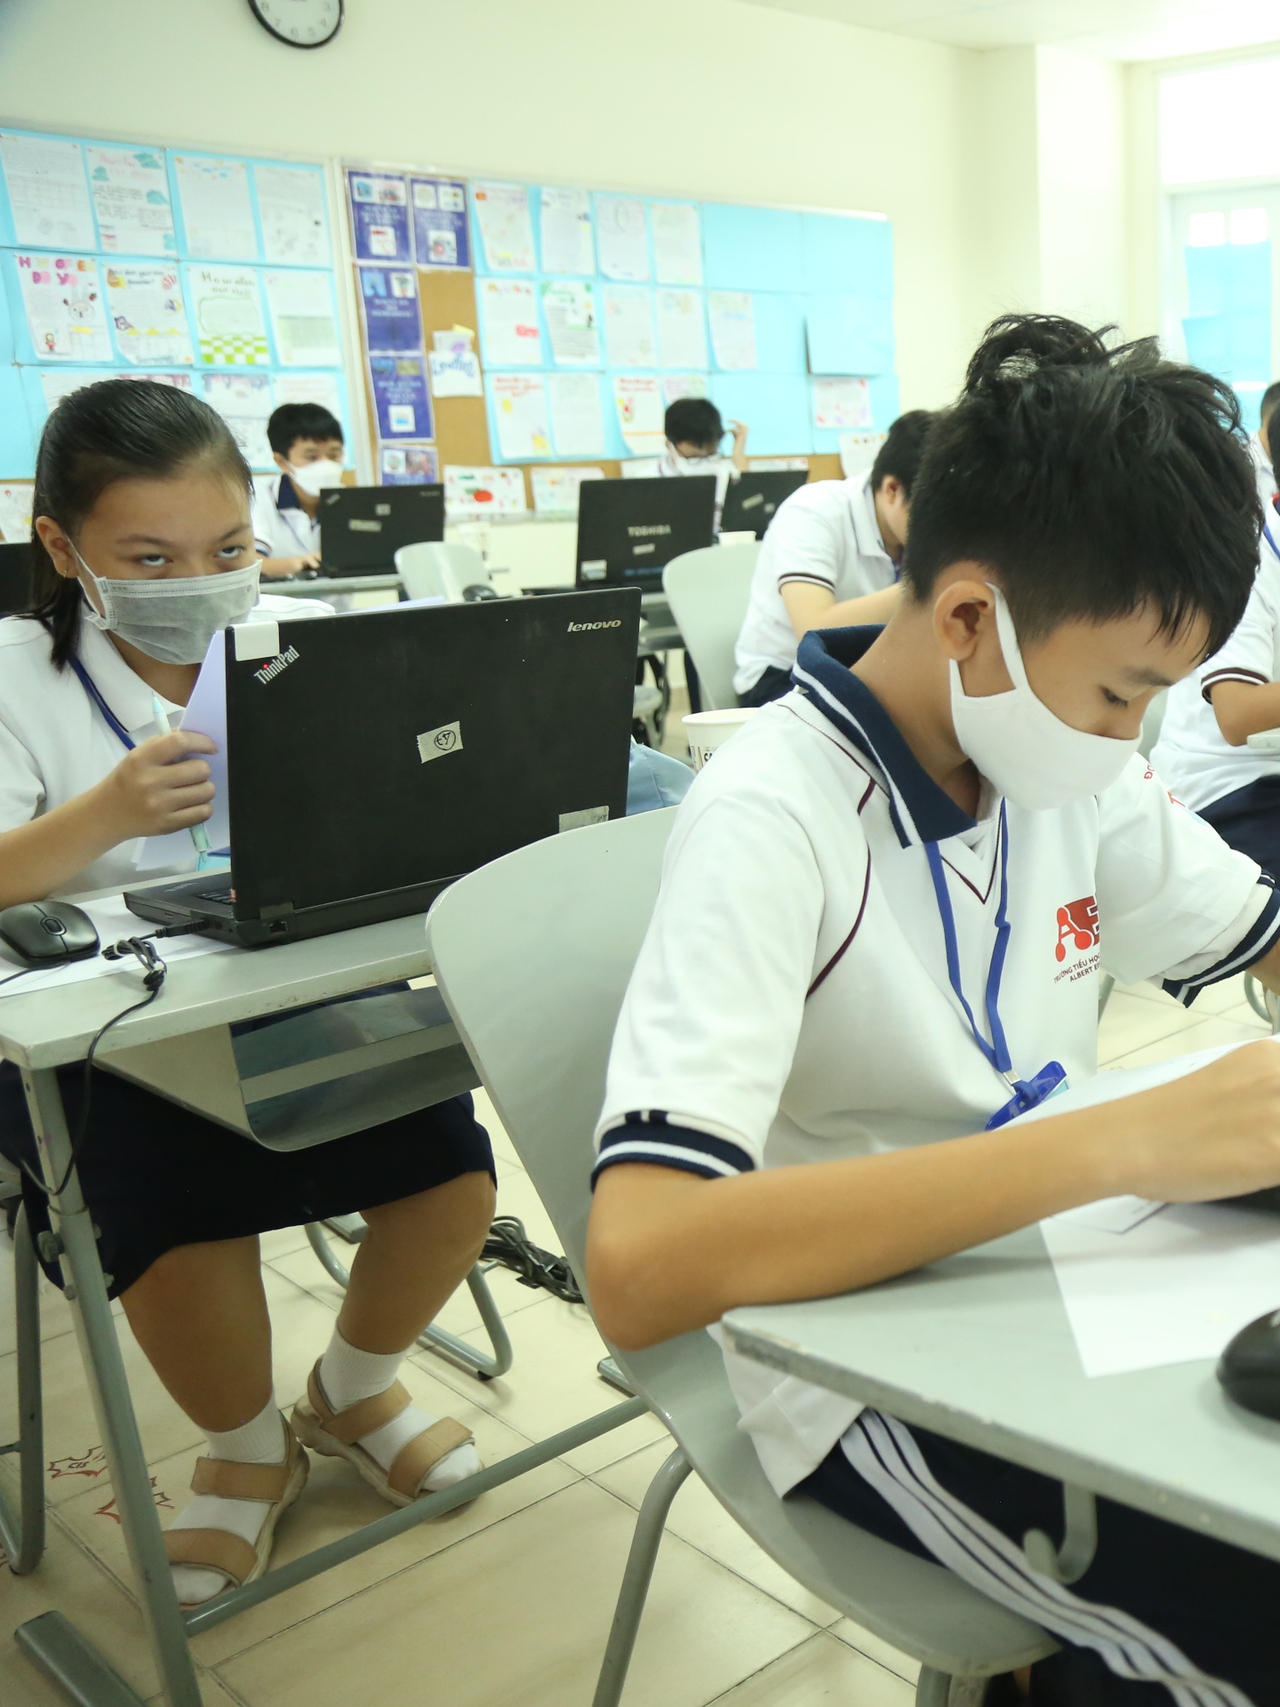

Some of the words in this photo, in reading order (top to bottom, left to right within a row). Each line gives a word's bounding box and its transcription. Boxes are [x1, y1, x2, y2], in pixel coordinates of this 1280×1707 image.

[567, 619, 622, 633] lenovo
[253, 644, 300, 685] ThinkPad
[1069, 965, 1093, 982] ALBERT
